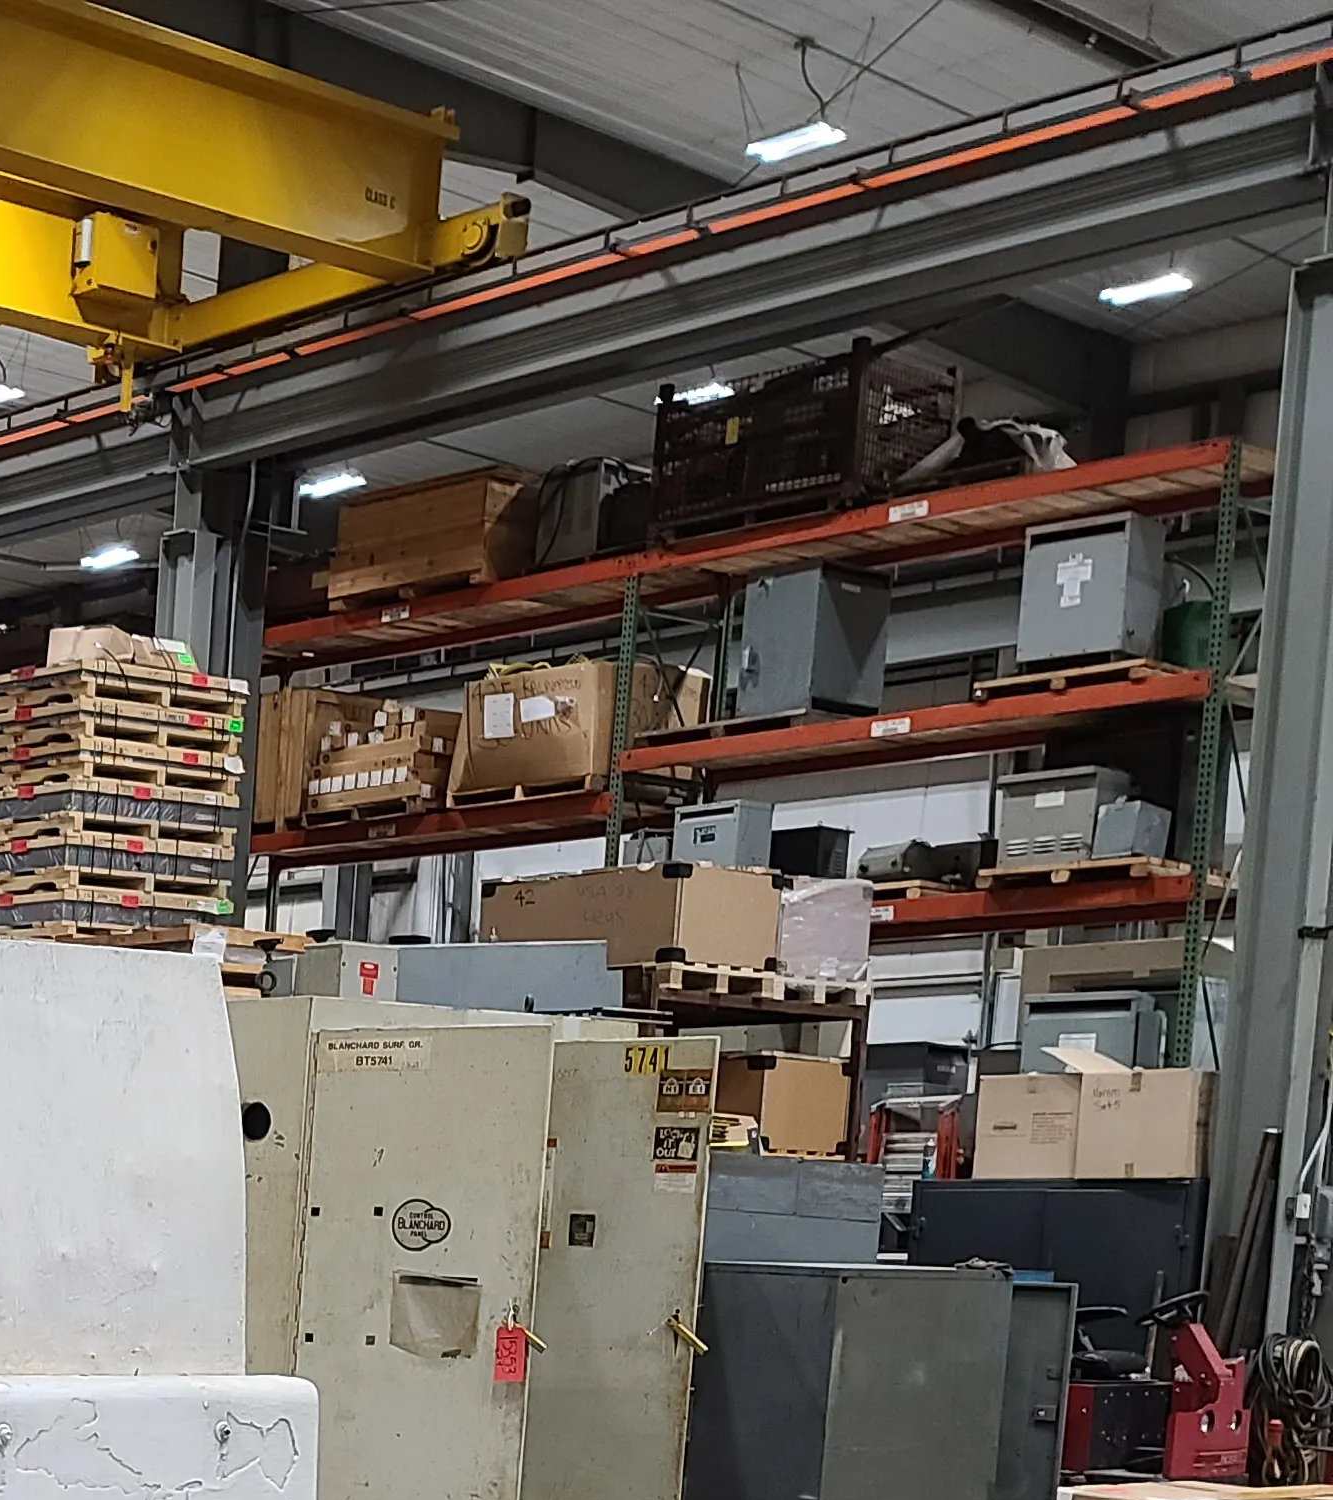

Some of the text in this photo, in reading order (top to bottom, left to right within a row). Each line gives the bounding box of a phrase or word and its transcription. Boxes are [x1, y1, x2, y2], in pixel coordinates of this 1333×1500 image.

[514, 889, 535, 907] 42
[328, 1041, 380, 1050] BLANCHARD
[356, 1056, 393, 1066] BT5741
[625, 1047, 669, 1073] 5741
[656, 1147, 676, 1157] OUT
[398, 1217, 445, 1230] BLANCHARD
